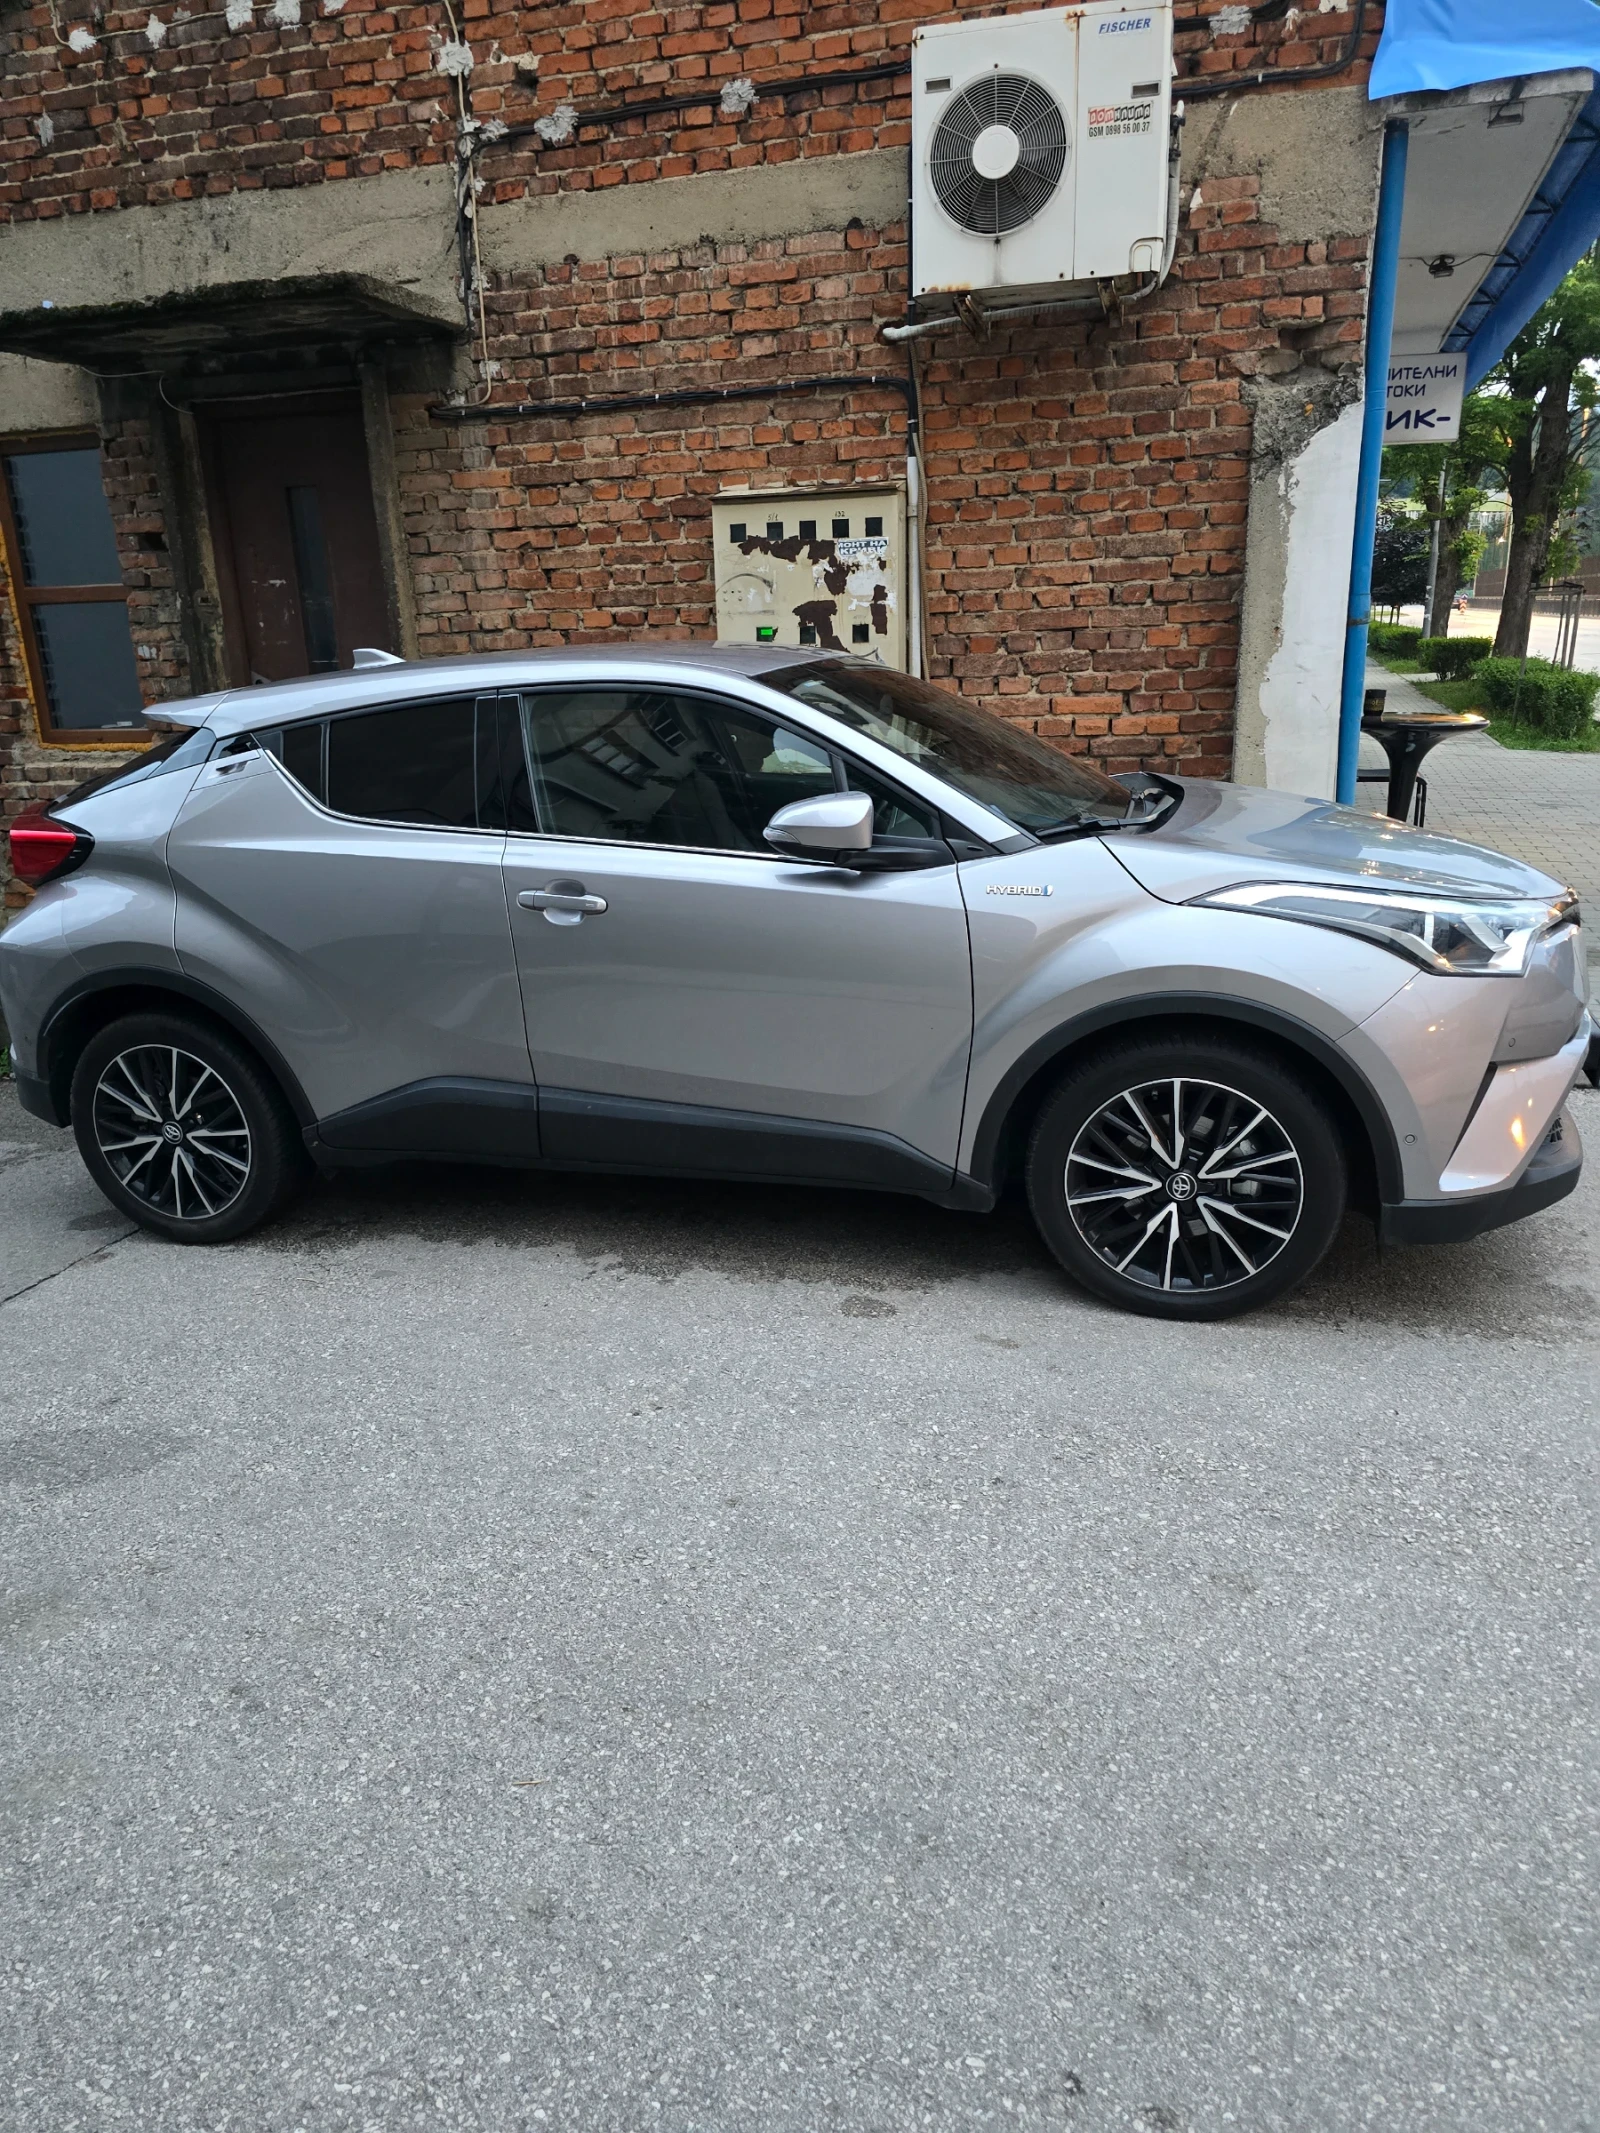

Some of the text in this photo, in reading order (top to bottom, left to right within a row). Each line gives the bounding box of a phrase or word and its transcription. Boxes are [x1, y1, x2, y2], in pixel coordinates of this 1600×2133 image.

[1098, 18, 1151, 34] FISCHER
[1088, 121, 1151, 138] GSM 0898 56 00 37
[1388, 365, 1457, 380] ИТЕЛНИ
[870, 539, 886, 547] НА
[986, 884, 1043, 896] HYBRID
